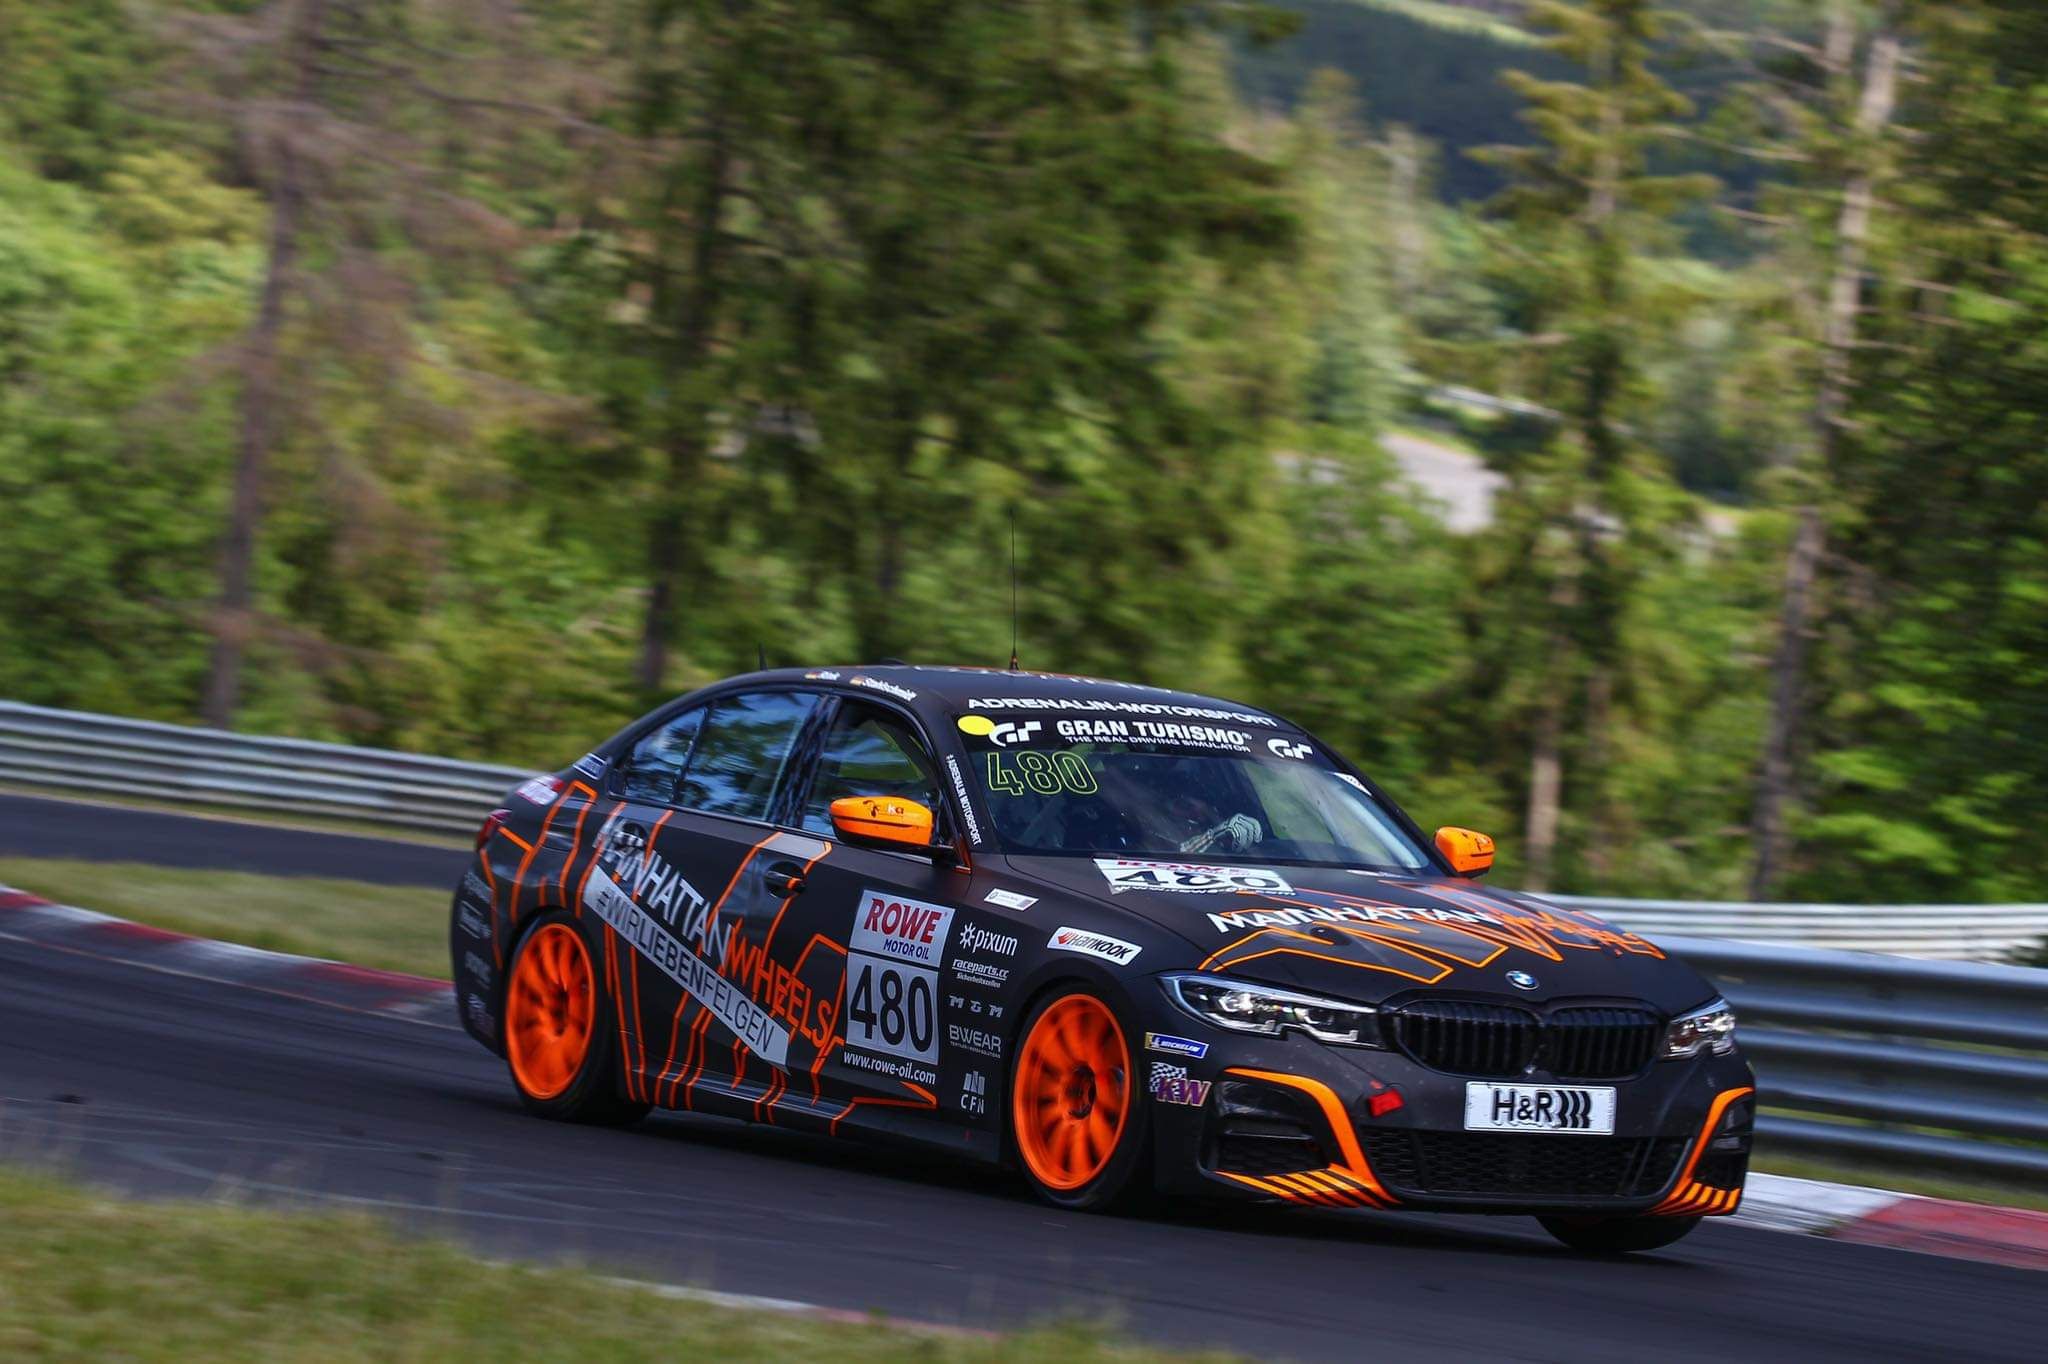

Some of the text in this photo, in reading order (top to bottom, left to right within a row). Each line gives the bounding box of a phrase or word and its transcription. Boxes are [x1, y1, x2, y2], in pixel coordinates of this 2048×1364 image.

[968, 698, 1278, 727] ADRENALIN-MOTORSPORT
[1056, 719, 1129, 736] GRAN
[1065, 735, 1252, 753] THE REAL DRIVING SIMULATOR
[987, 751, 1098, 795] 480
[960, 794, 982, 845] MOTORSPORT
[1114, 869, 1281, 889] 480
[863, 898, 942, 945] ROWE
[1206, 906, 1504, 934] MAINHATTAN
[883, 938, 929, 960] MOTOR OIL
[971, 929, 1018, 957] pixum
[597, 886, 775, 1053] #WIRLIEBENFELGEN
[722, 915, 834, 1048] WHEELS
[952, 959, 1010, 979] raceparts.cc
[850, 964, 934, 1053] 480
[949, 1024, 1002, 1052] BWEAR
[1160, 1040, 1201, 1053] MICHELIN
[843, 1051, 936, 1085] www.rowe-oil.com
[1156, 1077, 1213, 1107] KW
[1492, 1087, 1558, 1126] H&R
